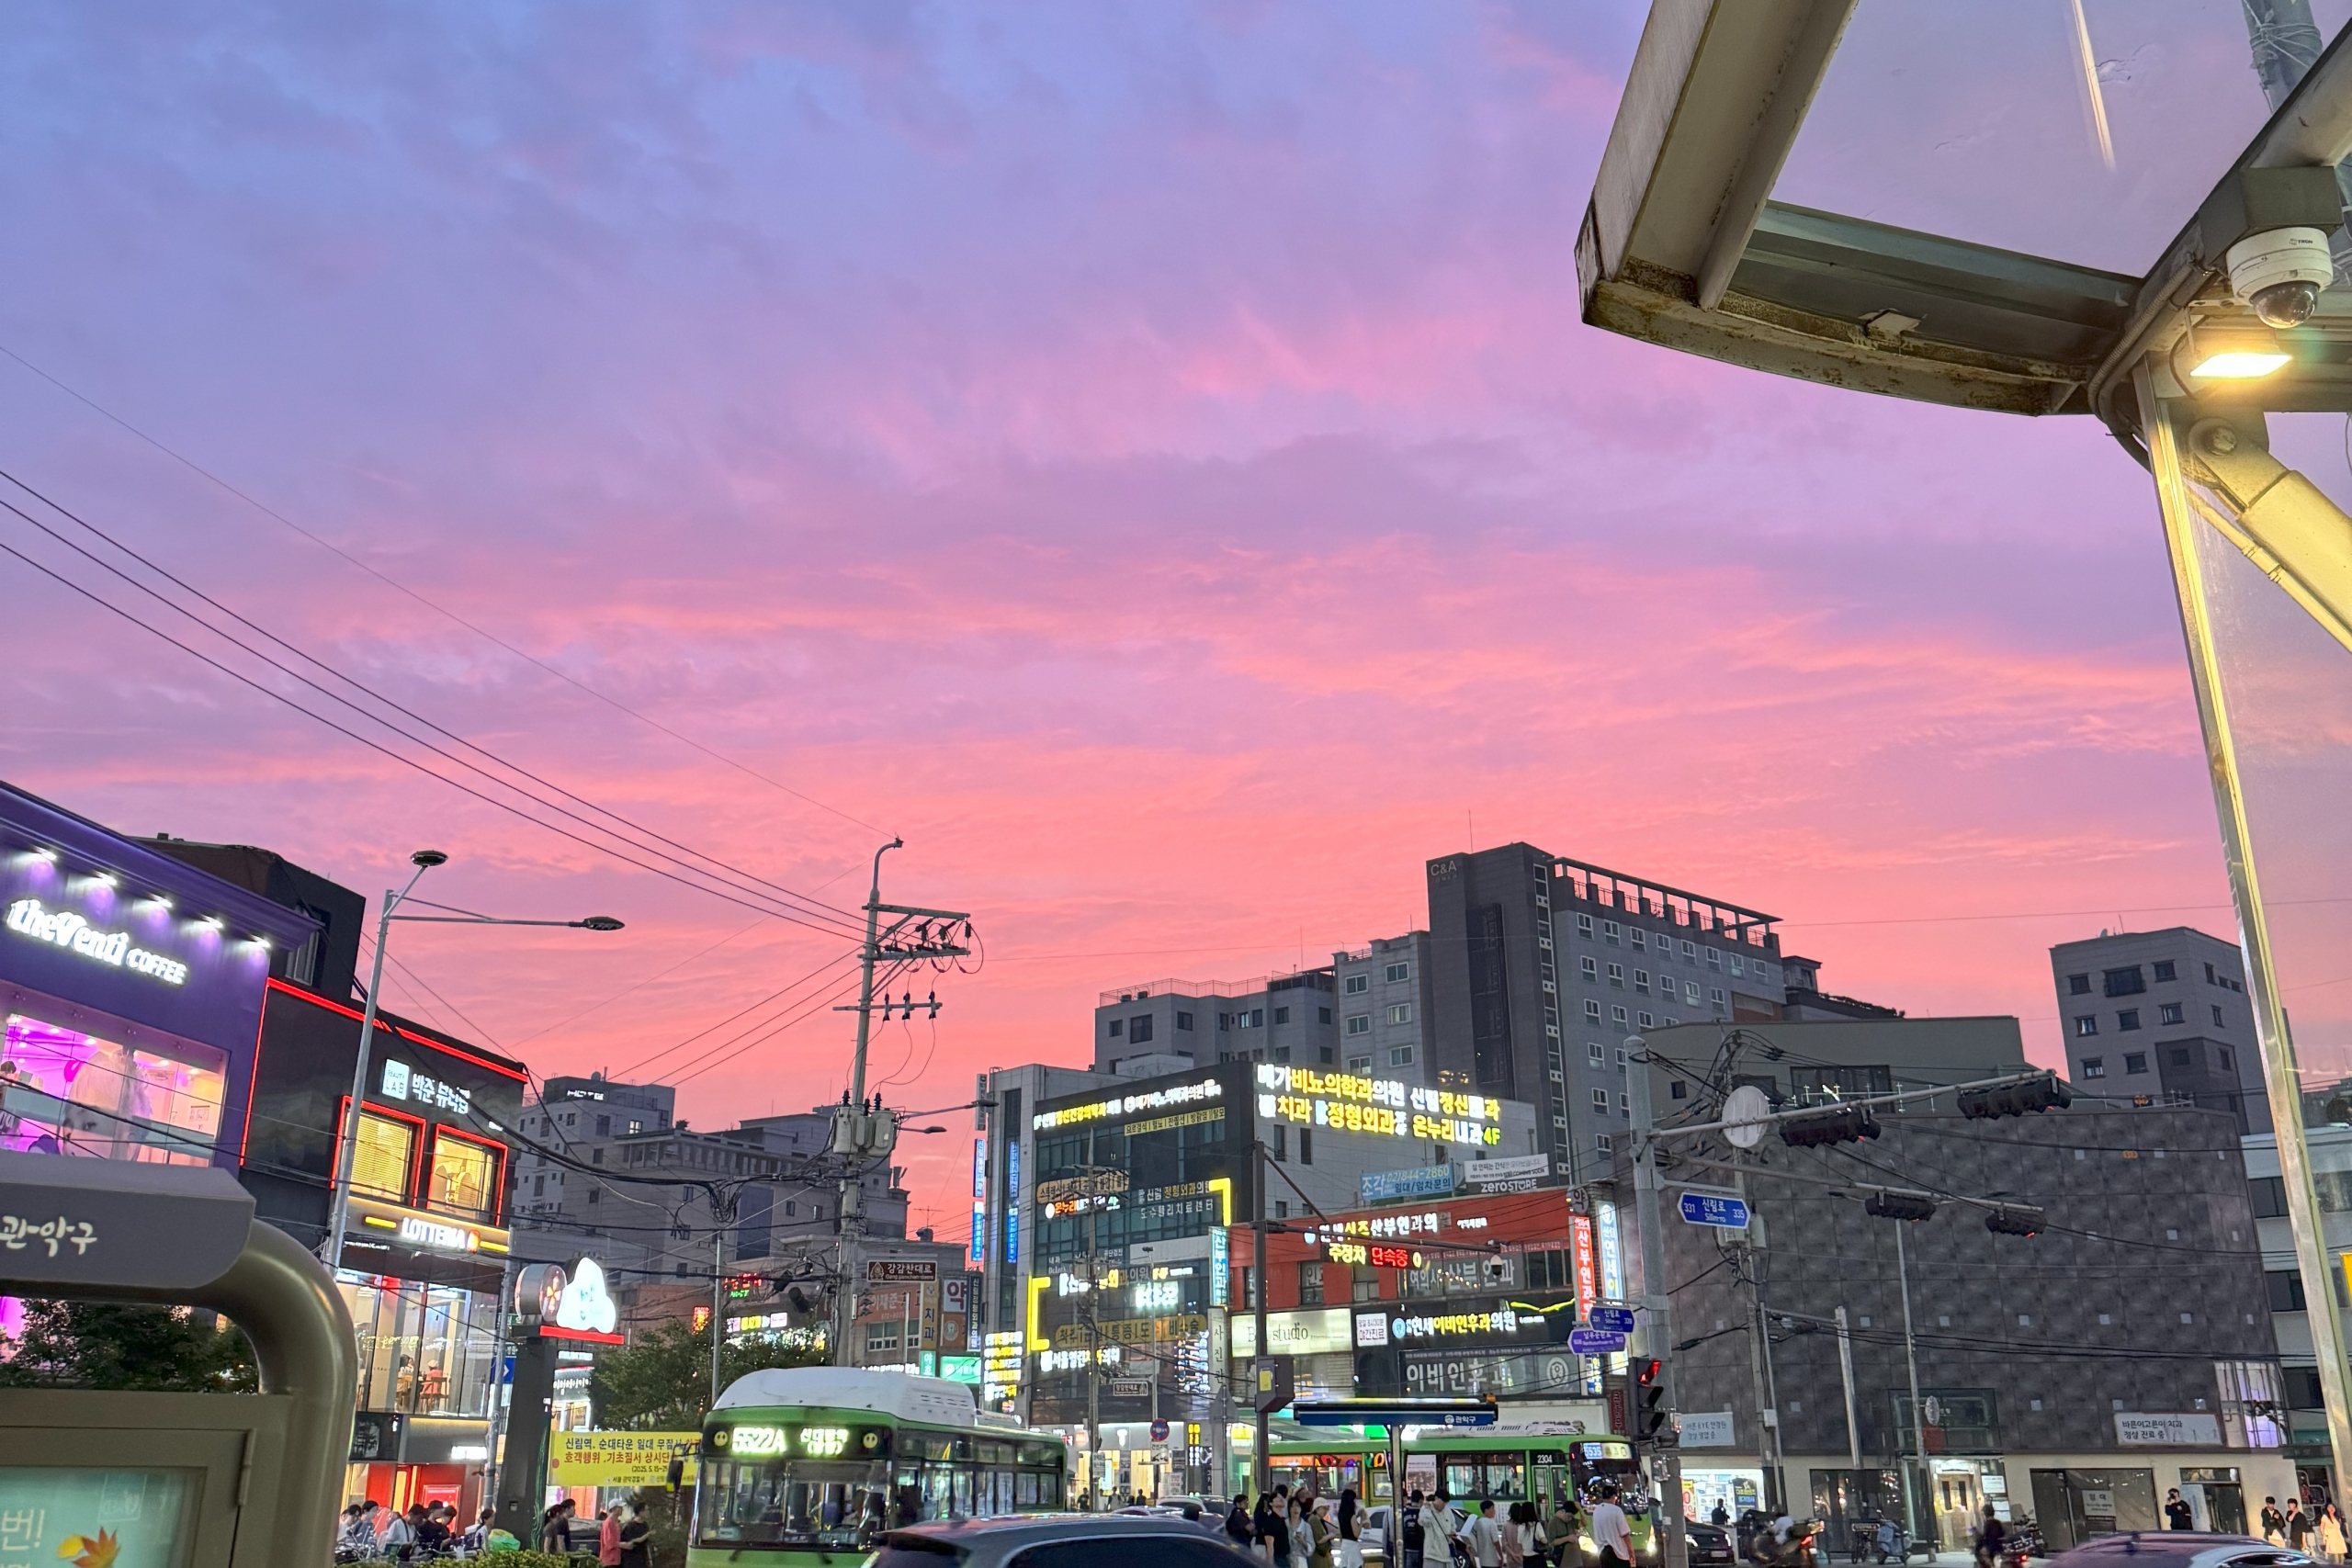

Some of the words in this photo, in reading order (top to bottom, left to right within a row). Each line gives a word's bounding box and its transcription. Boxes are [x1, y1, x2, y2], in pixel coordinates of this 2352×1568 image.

[1430, 860, 1457, 876] C&A
[7, 898, 130, 966] theVenti
[126, 948, 187, 985] COFFEE
[386, 1079, 404, 1094] LAB
[1257, 1063, 1405, 1107] 메가비뇨의학과의원
[1484, 1127, 1500, 1145] 4F
[1386, 1166, 1450, 1182] 02)844-2860
[1683, 1202, 1696, 1213] 331
[1702, 1198, 1726, 1213] 신림로
[1732, 1208, 1745, 1219] 335
[0, 1215, 97, 1258] 관악구
[1329, 1242, 1366, 1265] 주정차
[1371, 1247, 1408, 1268] 단속중
[887, 1263, 933, 1274] 강감찬대로
[1577, 1230, 1595, 1299] 산부인과
[1604, 1309, 1621, 1318] 신림로
[924, 1307, 935, 1342] 치과
[1272, 1322, 1308, 1342] studio
[1359, 1328, 1385, 1341] 야간진료
[1455, 1416, 1476, 1424] 관악구
[2168, 1420, 2183, 1428] 치과
[732, 1427, 787, 1453] 5522A
[2141, 1430, 2155, 1439] 진료
[565, 1438, 595, 1450] 신림역.
[599, 1438, 634, 1450] 순대타운
[564, 1451, 600, 1464] 호객행위
[645, 1451, 671, 1464] 상시단
[1537, 1454, 1553, 1463] 2304
